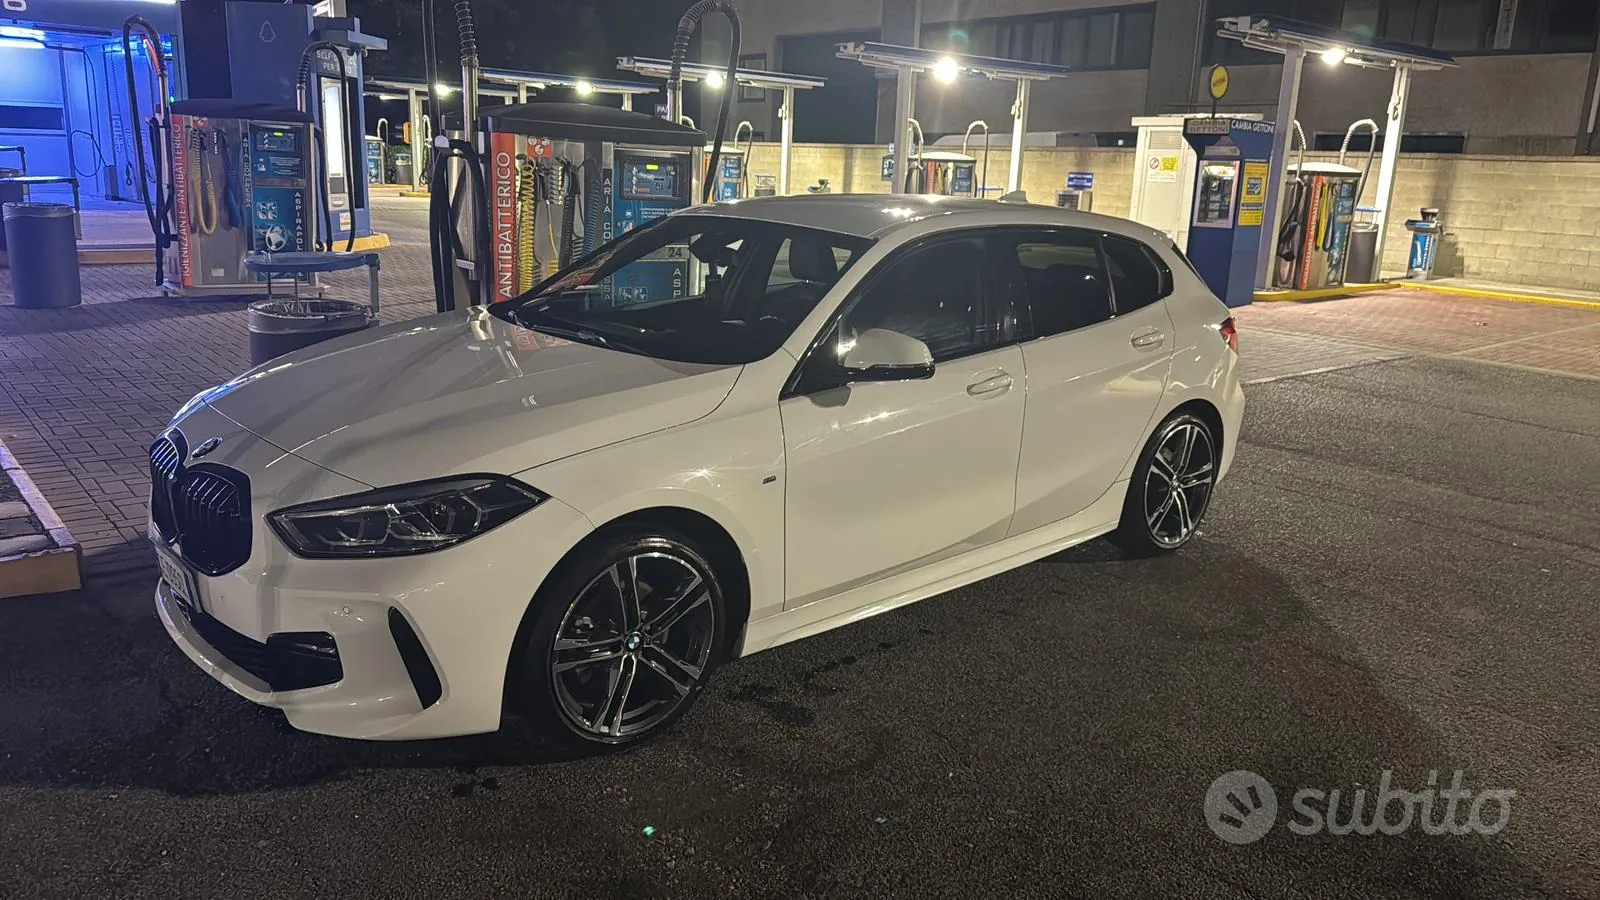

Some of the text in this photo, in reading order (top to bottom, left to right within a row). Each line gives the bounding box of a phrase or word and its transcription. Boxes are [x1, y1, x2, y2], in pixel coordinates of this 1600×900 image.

[1231, 120, 1252, 130] CAMBIA
[174, 125, 190, 277] IGIENIZZANTE ANTIBATTERICO
[496, 151, 513, 298] ANTIBATTERICO
[603, 178, 611, 213] ARIA
